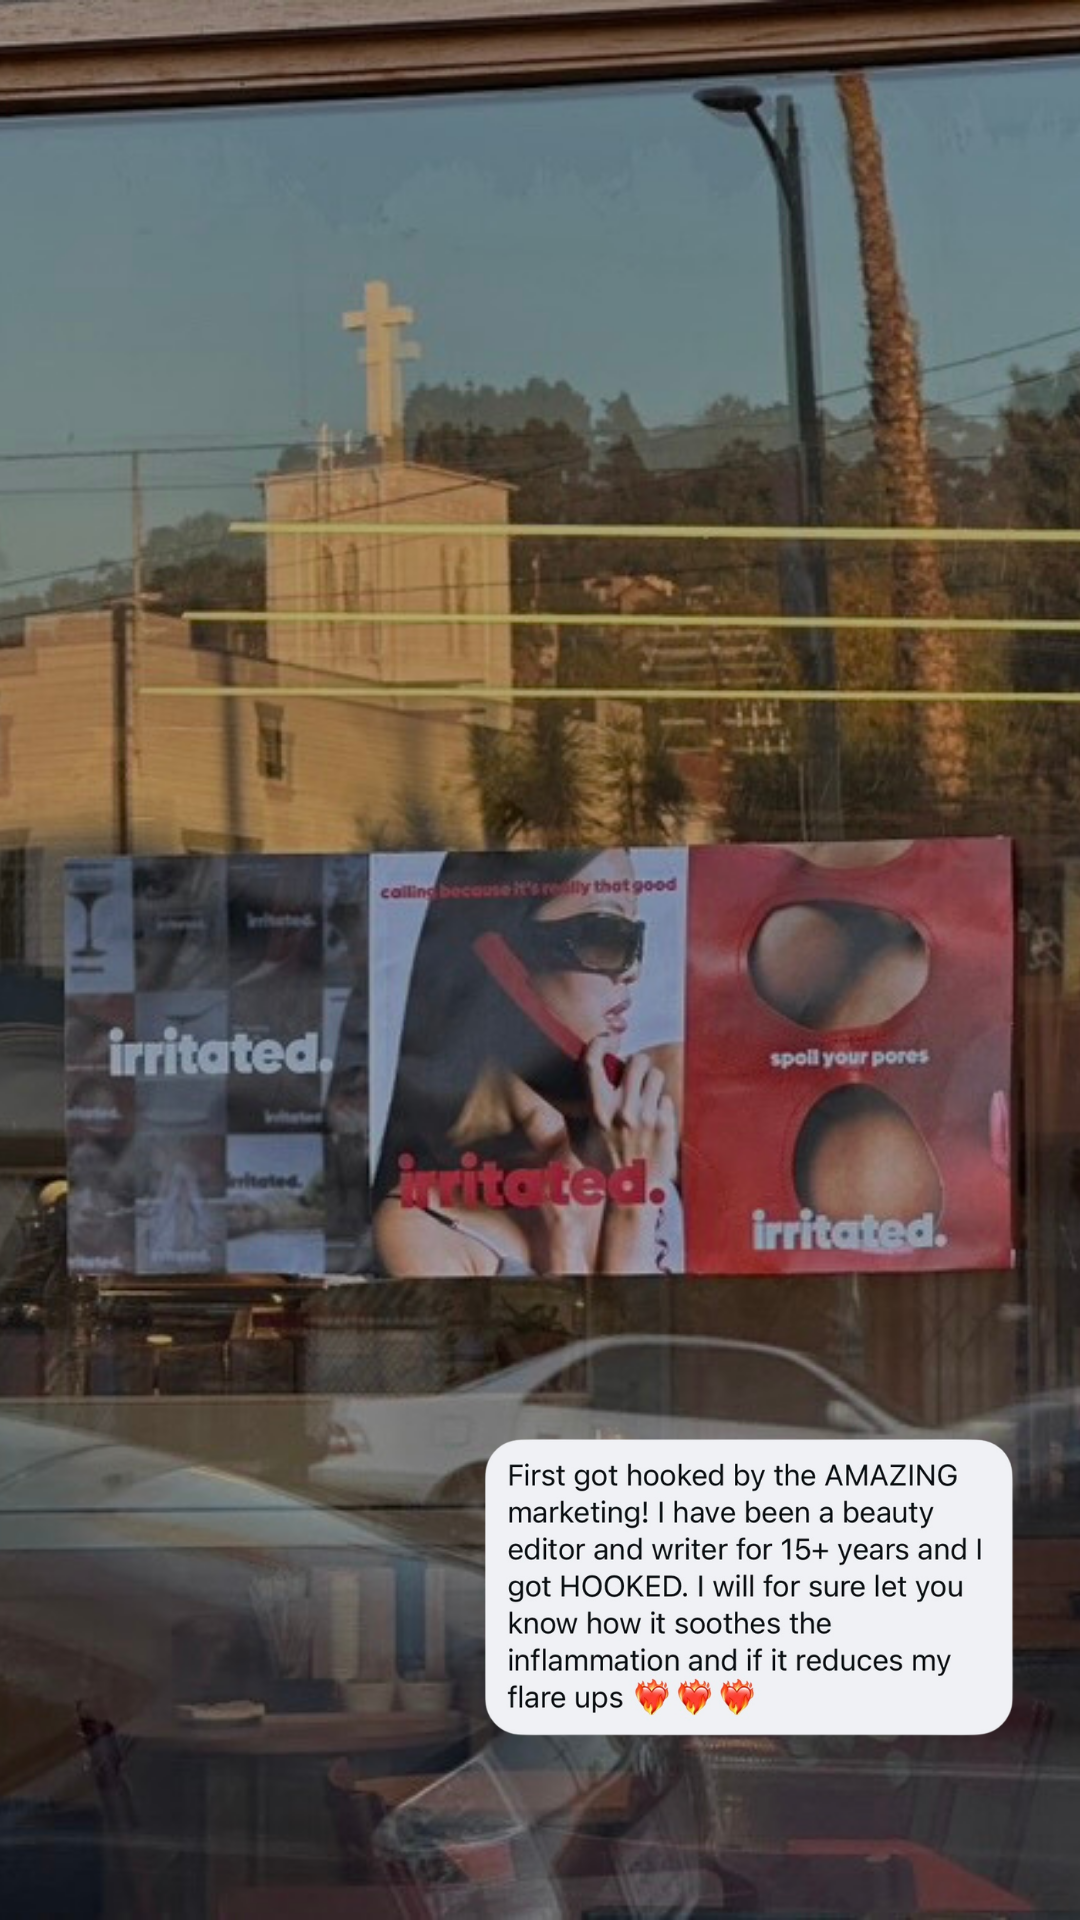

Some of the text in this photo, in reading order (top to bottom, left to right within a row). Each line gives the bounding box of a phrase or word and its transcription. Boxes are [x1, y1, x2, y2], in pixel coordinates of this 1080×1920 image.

[380, 877, 677, 901] calling because it's really that good
[108, 1026, 334, 1077] irritated.
[770, 1049, 930, 1069] spoil your pores
[398, 1152, 666, 1209] irritated.
[752, 1208, 948, 1250] irritated.
